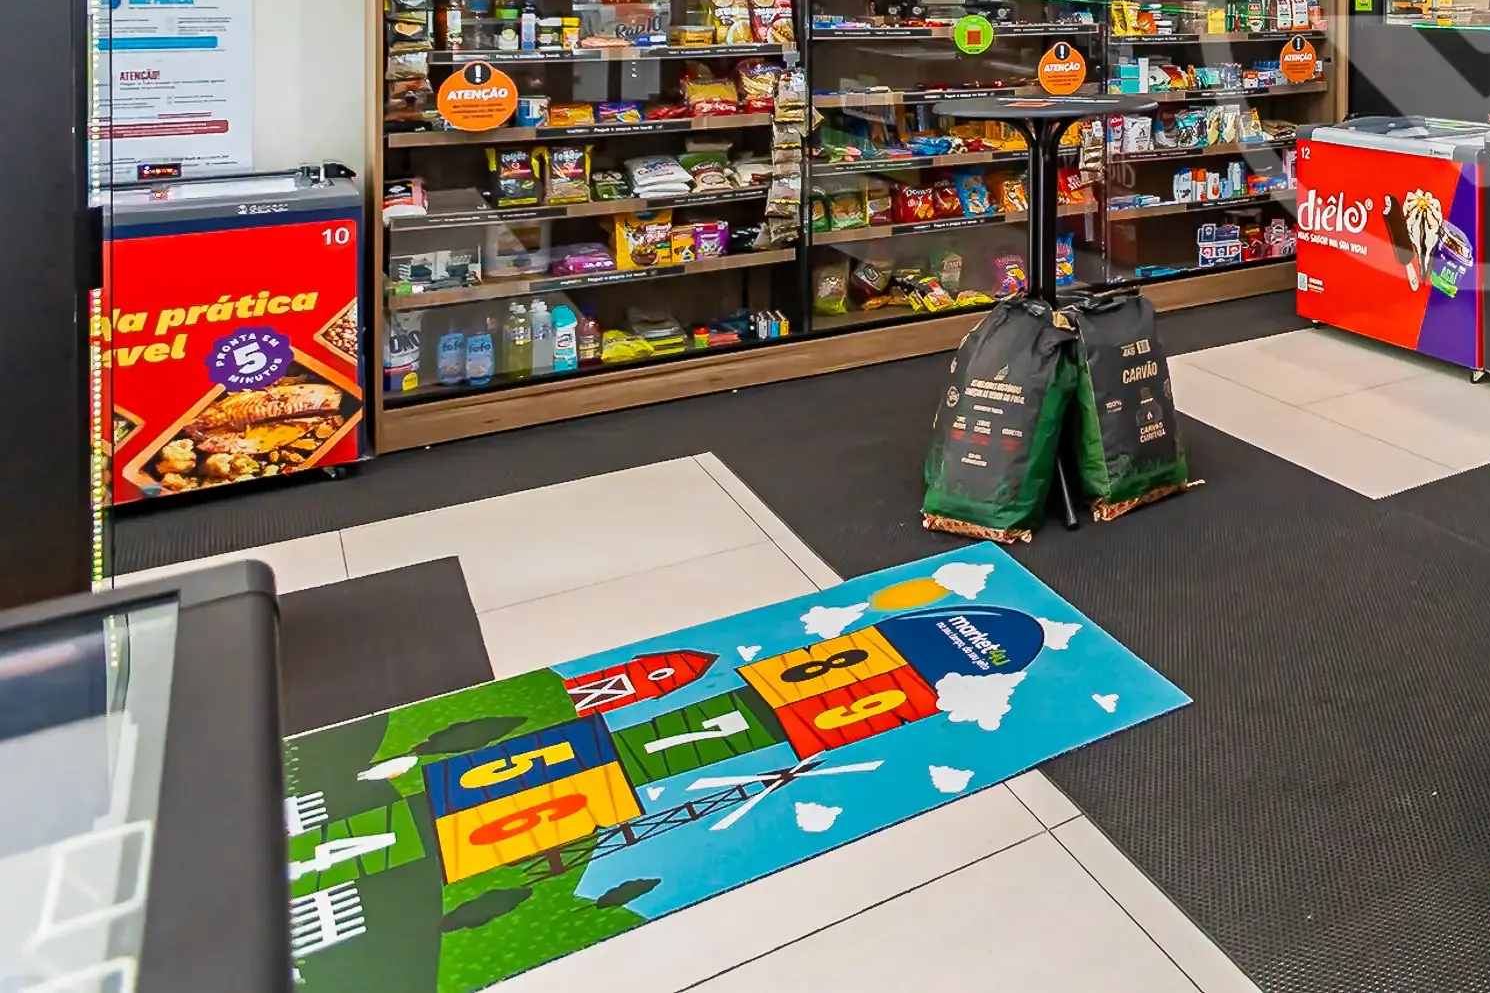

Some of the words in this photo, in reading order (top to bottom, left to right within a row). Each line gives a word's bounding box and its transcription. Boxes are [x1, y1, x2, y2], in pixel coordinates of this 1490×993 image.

[1044, 61, 1081, 73] ATENÇÃO
[446, 86, 509, 102] ATENÇÃO
[1301, 147, 1311, 160] 12
[321, 227, 350, 245] 10
[154, 290, 319, 336] prática
[215, 333, 257, 367] PRONTA
[232, 341, 268, 375] 5
[228, 358, 283, 384] MINUTOS
[1122, 360, 1158, 384] CARVÃO
[780, 649, 869, 683] 8
[814, 690, 908, 730] 9
[644, 709, 750, 754] 7
[460, 741, 574, 789] 5
[469, 794, 588, 845] 6
